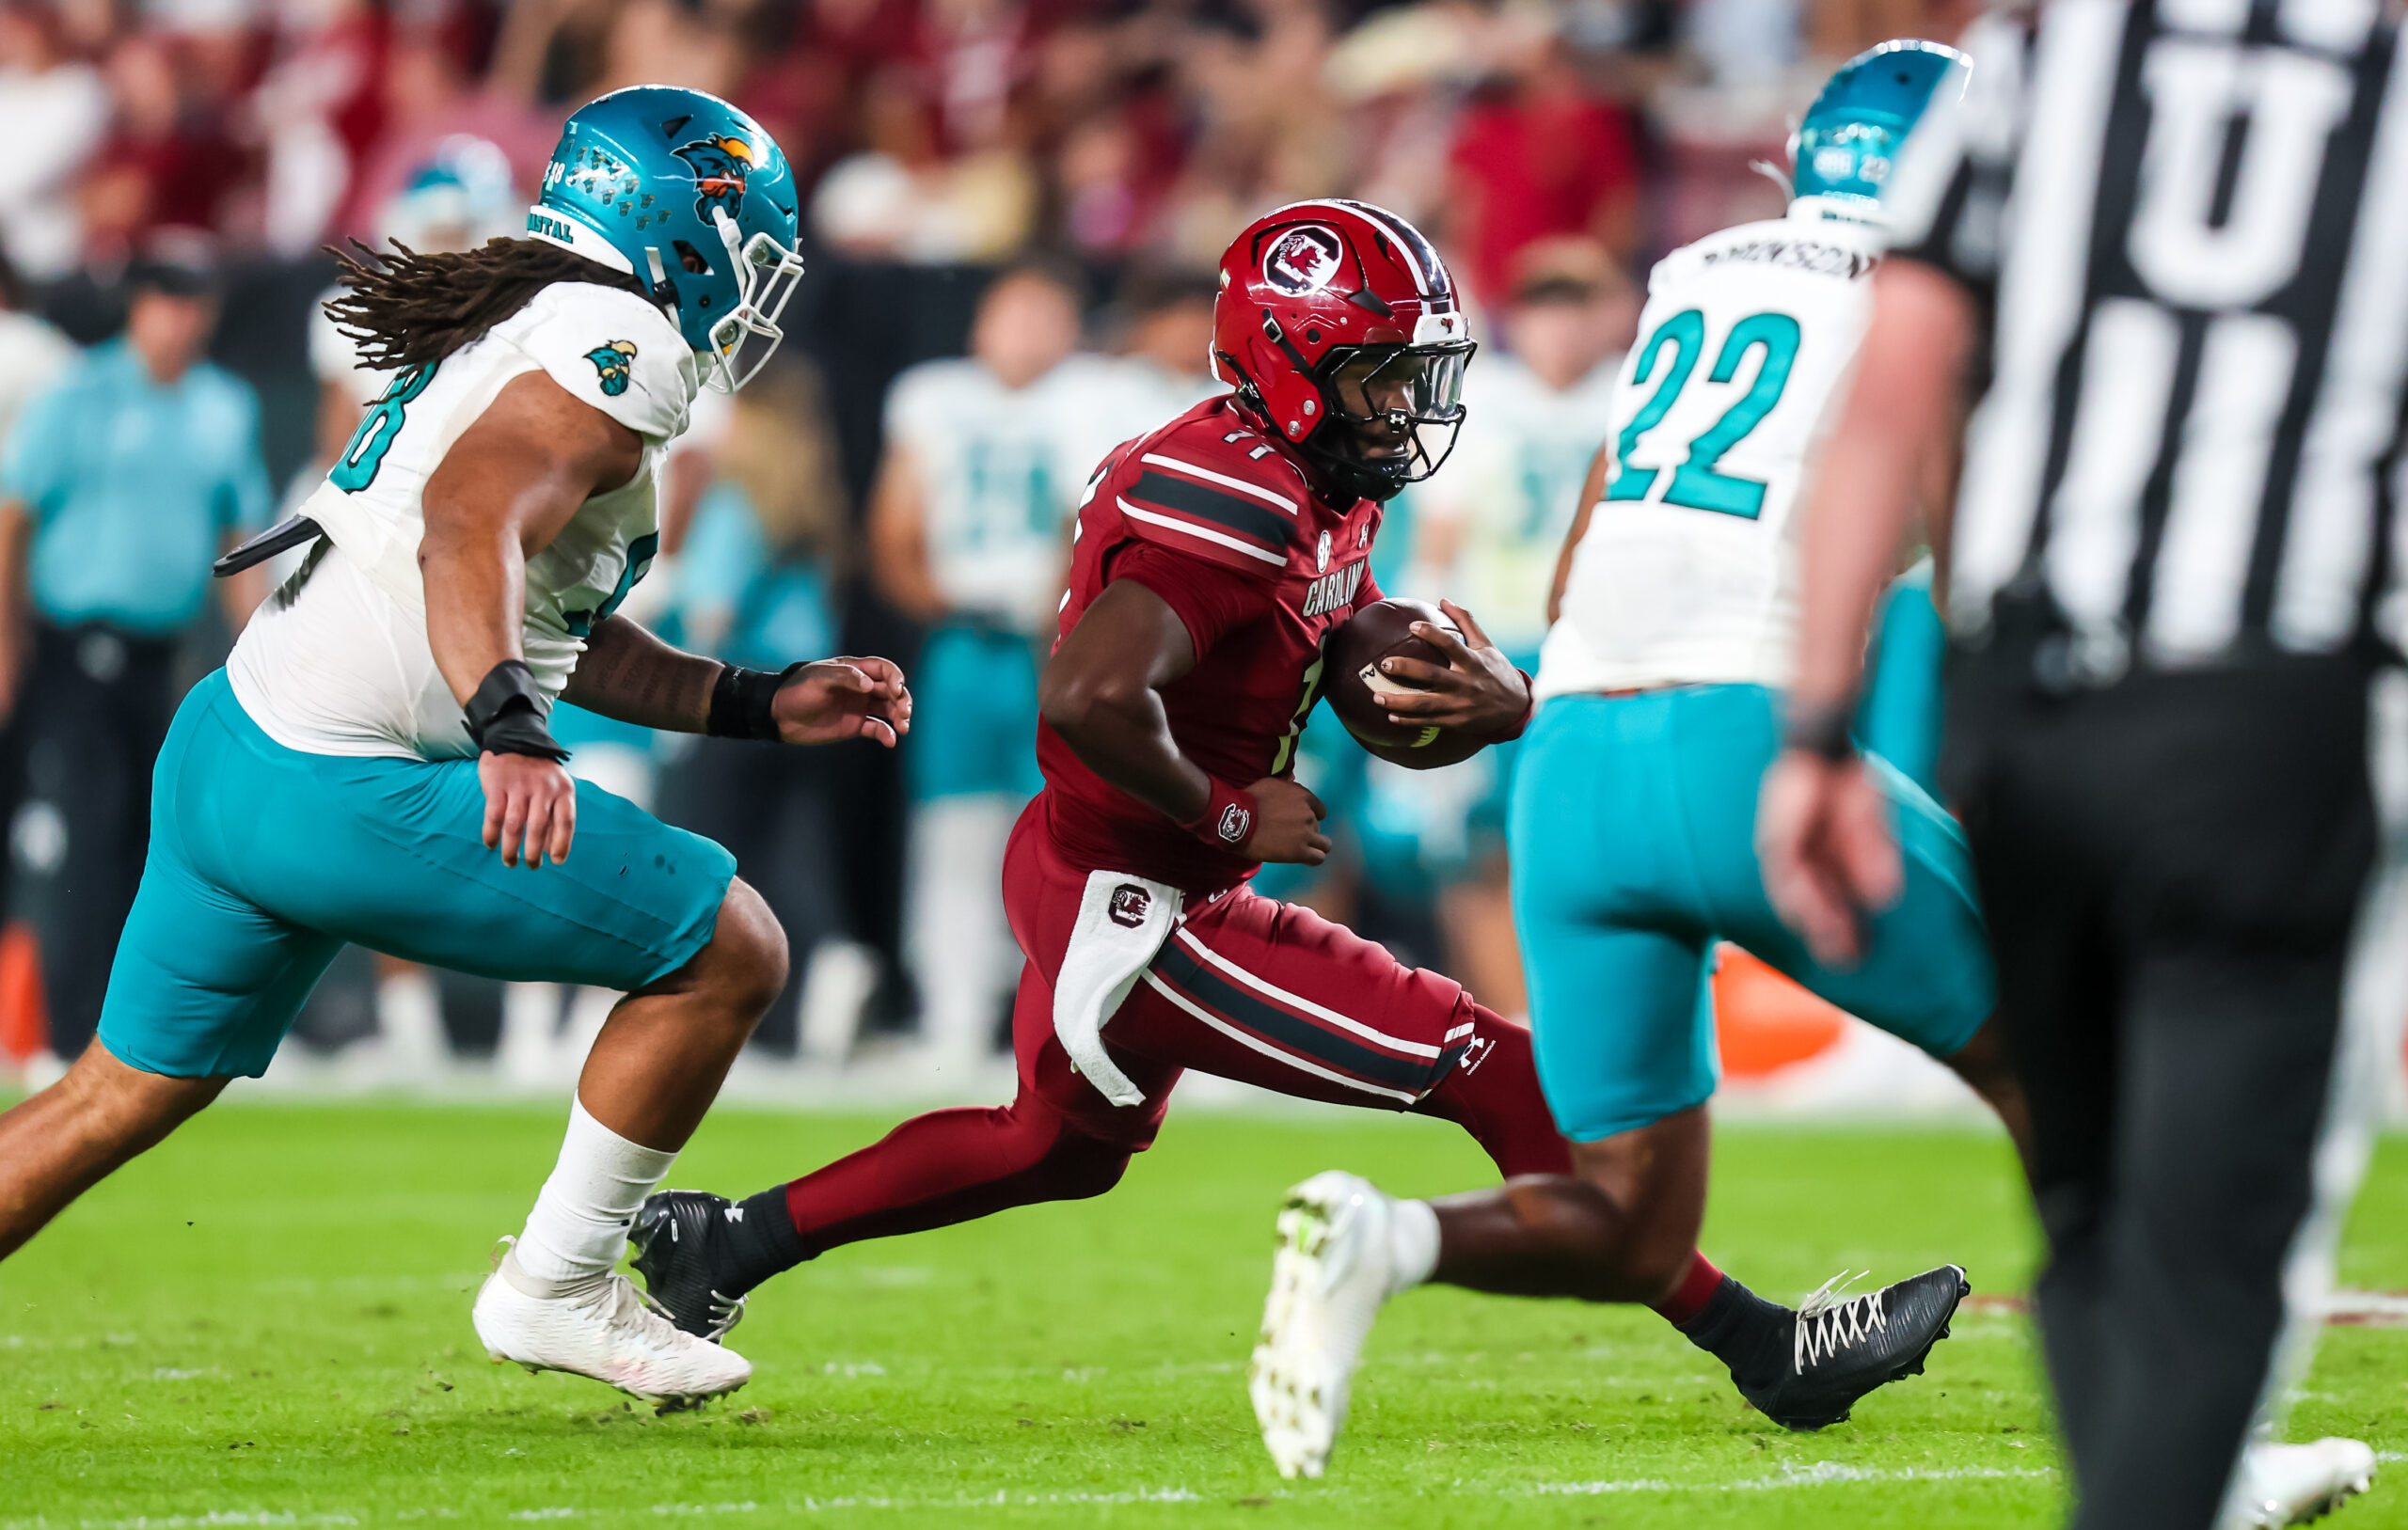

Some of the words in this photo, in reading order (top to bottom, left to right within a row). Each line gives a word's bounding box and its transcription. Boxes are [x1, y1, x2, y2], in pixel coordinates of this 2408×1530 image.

[2126, 39, 2355, 308] U
[527, 213, 574, 244] ASTAL
[1606, 308, 1800, 521] 22
[1302, 557, 1367, 618] CAROLIN
[1466, 1060, 1481, 1076] UNDER
[1480, 1039, 1497, 1062] ARMOUR
